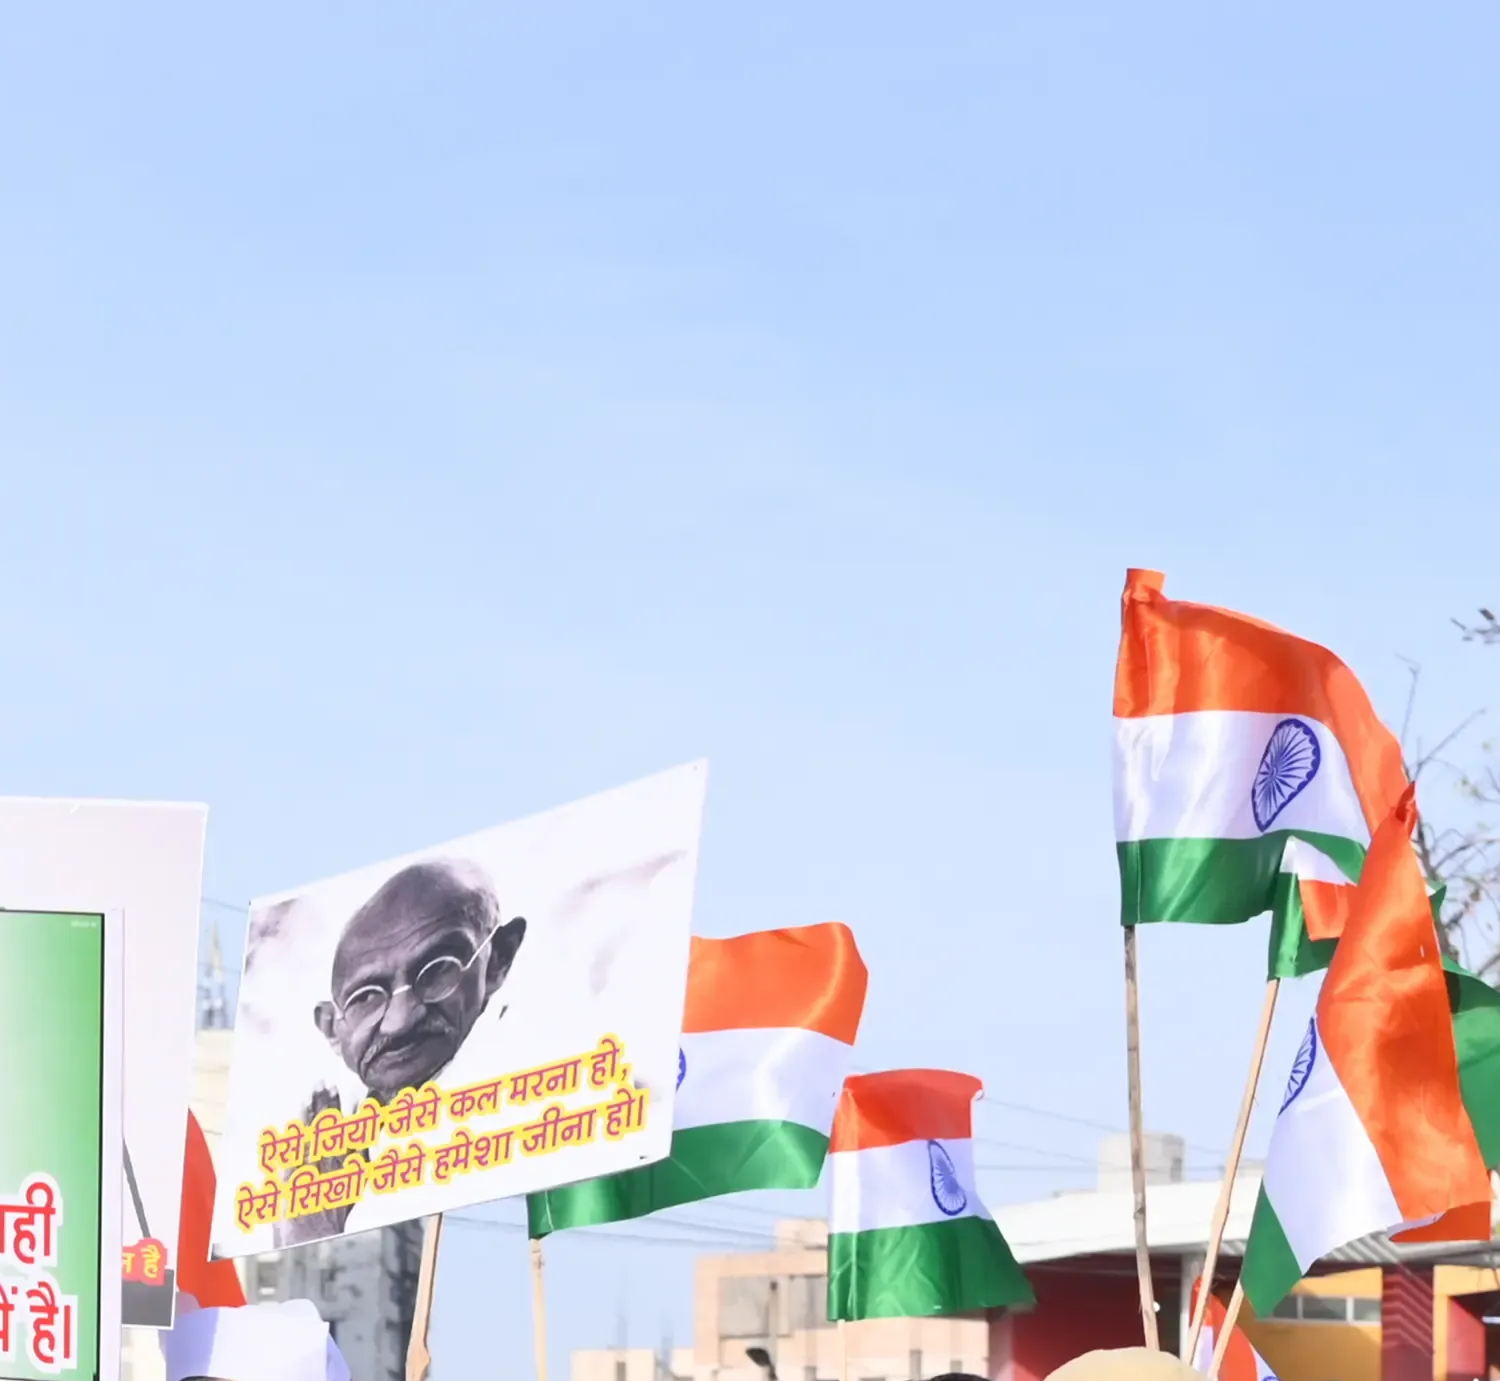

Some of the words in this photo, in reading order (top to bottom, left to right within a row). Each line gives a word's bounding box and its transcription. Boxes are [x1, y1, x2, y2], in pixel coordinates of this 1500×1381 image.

[261, 1130, 304, 1169] ऐसे
[313, 1108, 380, 1155] जियो
[388, 1089, 441, 1135] जैसे
[449, 1081, 501, 1117] कल
[509, 1060, 581, 1100] मरना
[590, 1039, 628, 1086] हो,
[237, 1183, 281, 1228] ऐसे
[290, 1159, 365, 1213] सिखो
[374, 1144, 426, 1191] जैसे
[434, 1132, 512, 1182] हमेशा
[522, 1107, 596, 1153] जीना
[141, 1244, 161, 1278] है
[28, 1282, 70, 1363] है।
